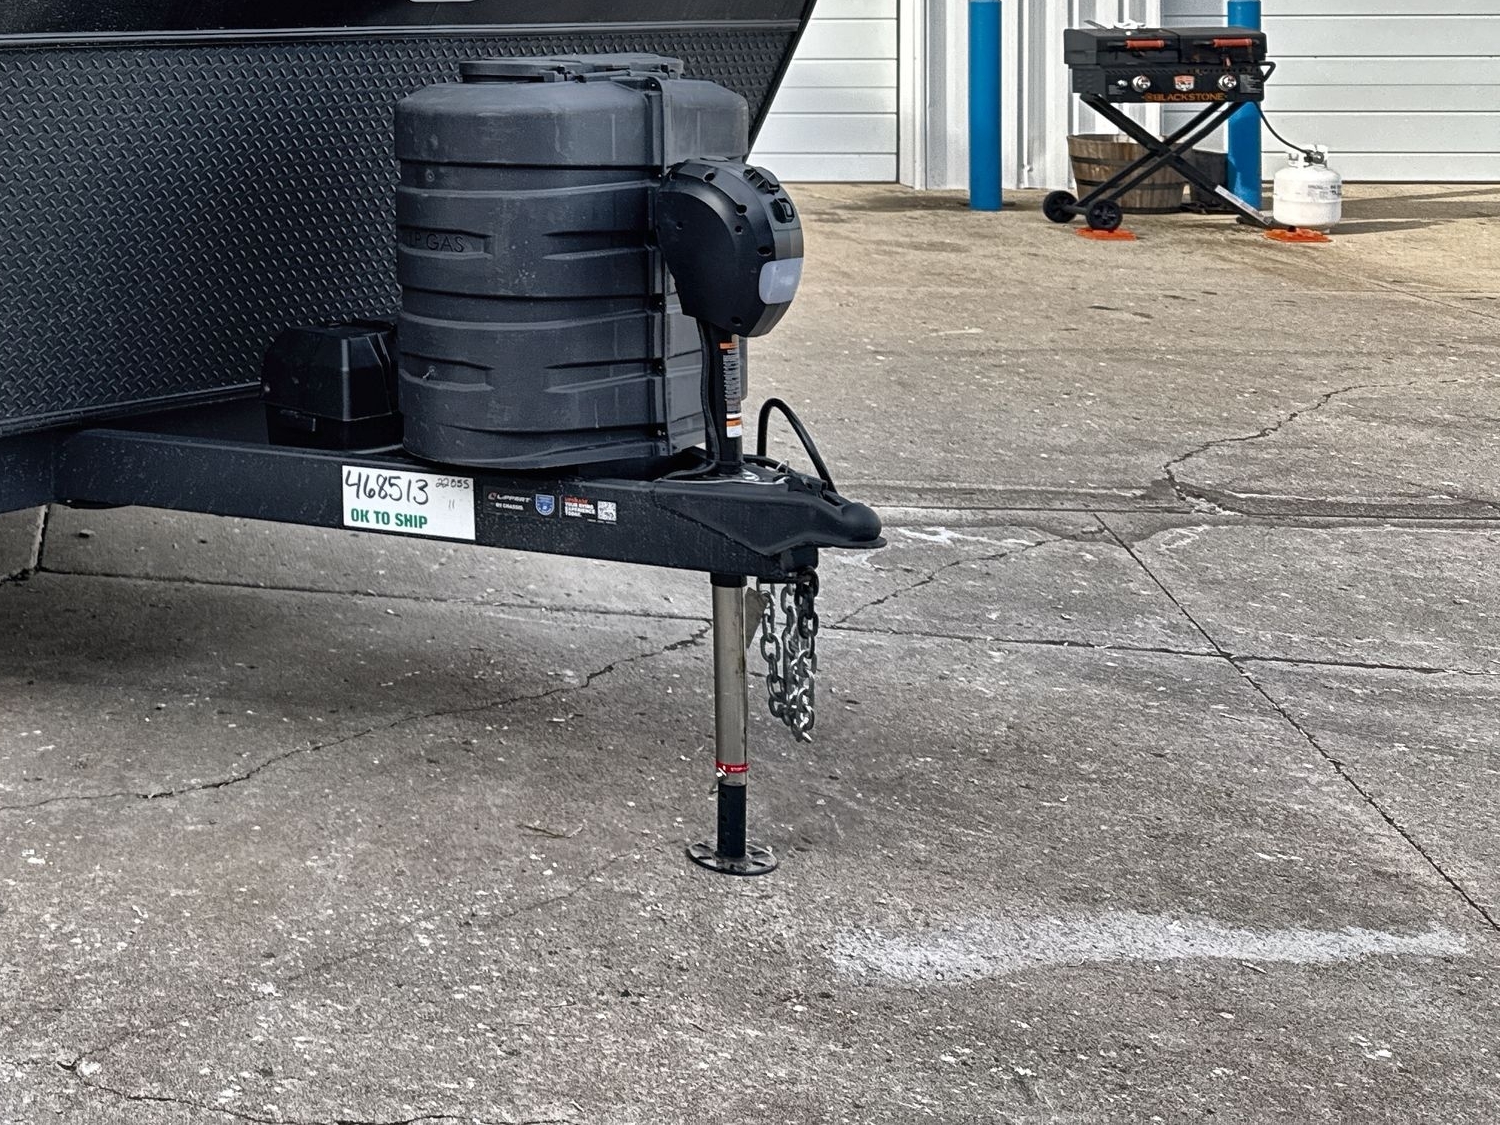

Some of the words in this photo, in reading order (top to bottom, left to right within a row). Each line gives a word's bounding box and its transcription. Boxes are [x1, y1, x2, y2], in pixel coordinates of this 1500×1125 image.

[1153, 92, 1225, 102] BLACKSTONE
[426, 233, 465, 253] GAS
[344, 469, 429, 506] 468513
[350, 508, 370, 524] OK
[373, 510, 391, 526] TO
[394, 512, 429, 530] SHIP
